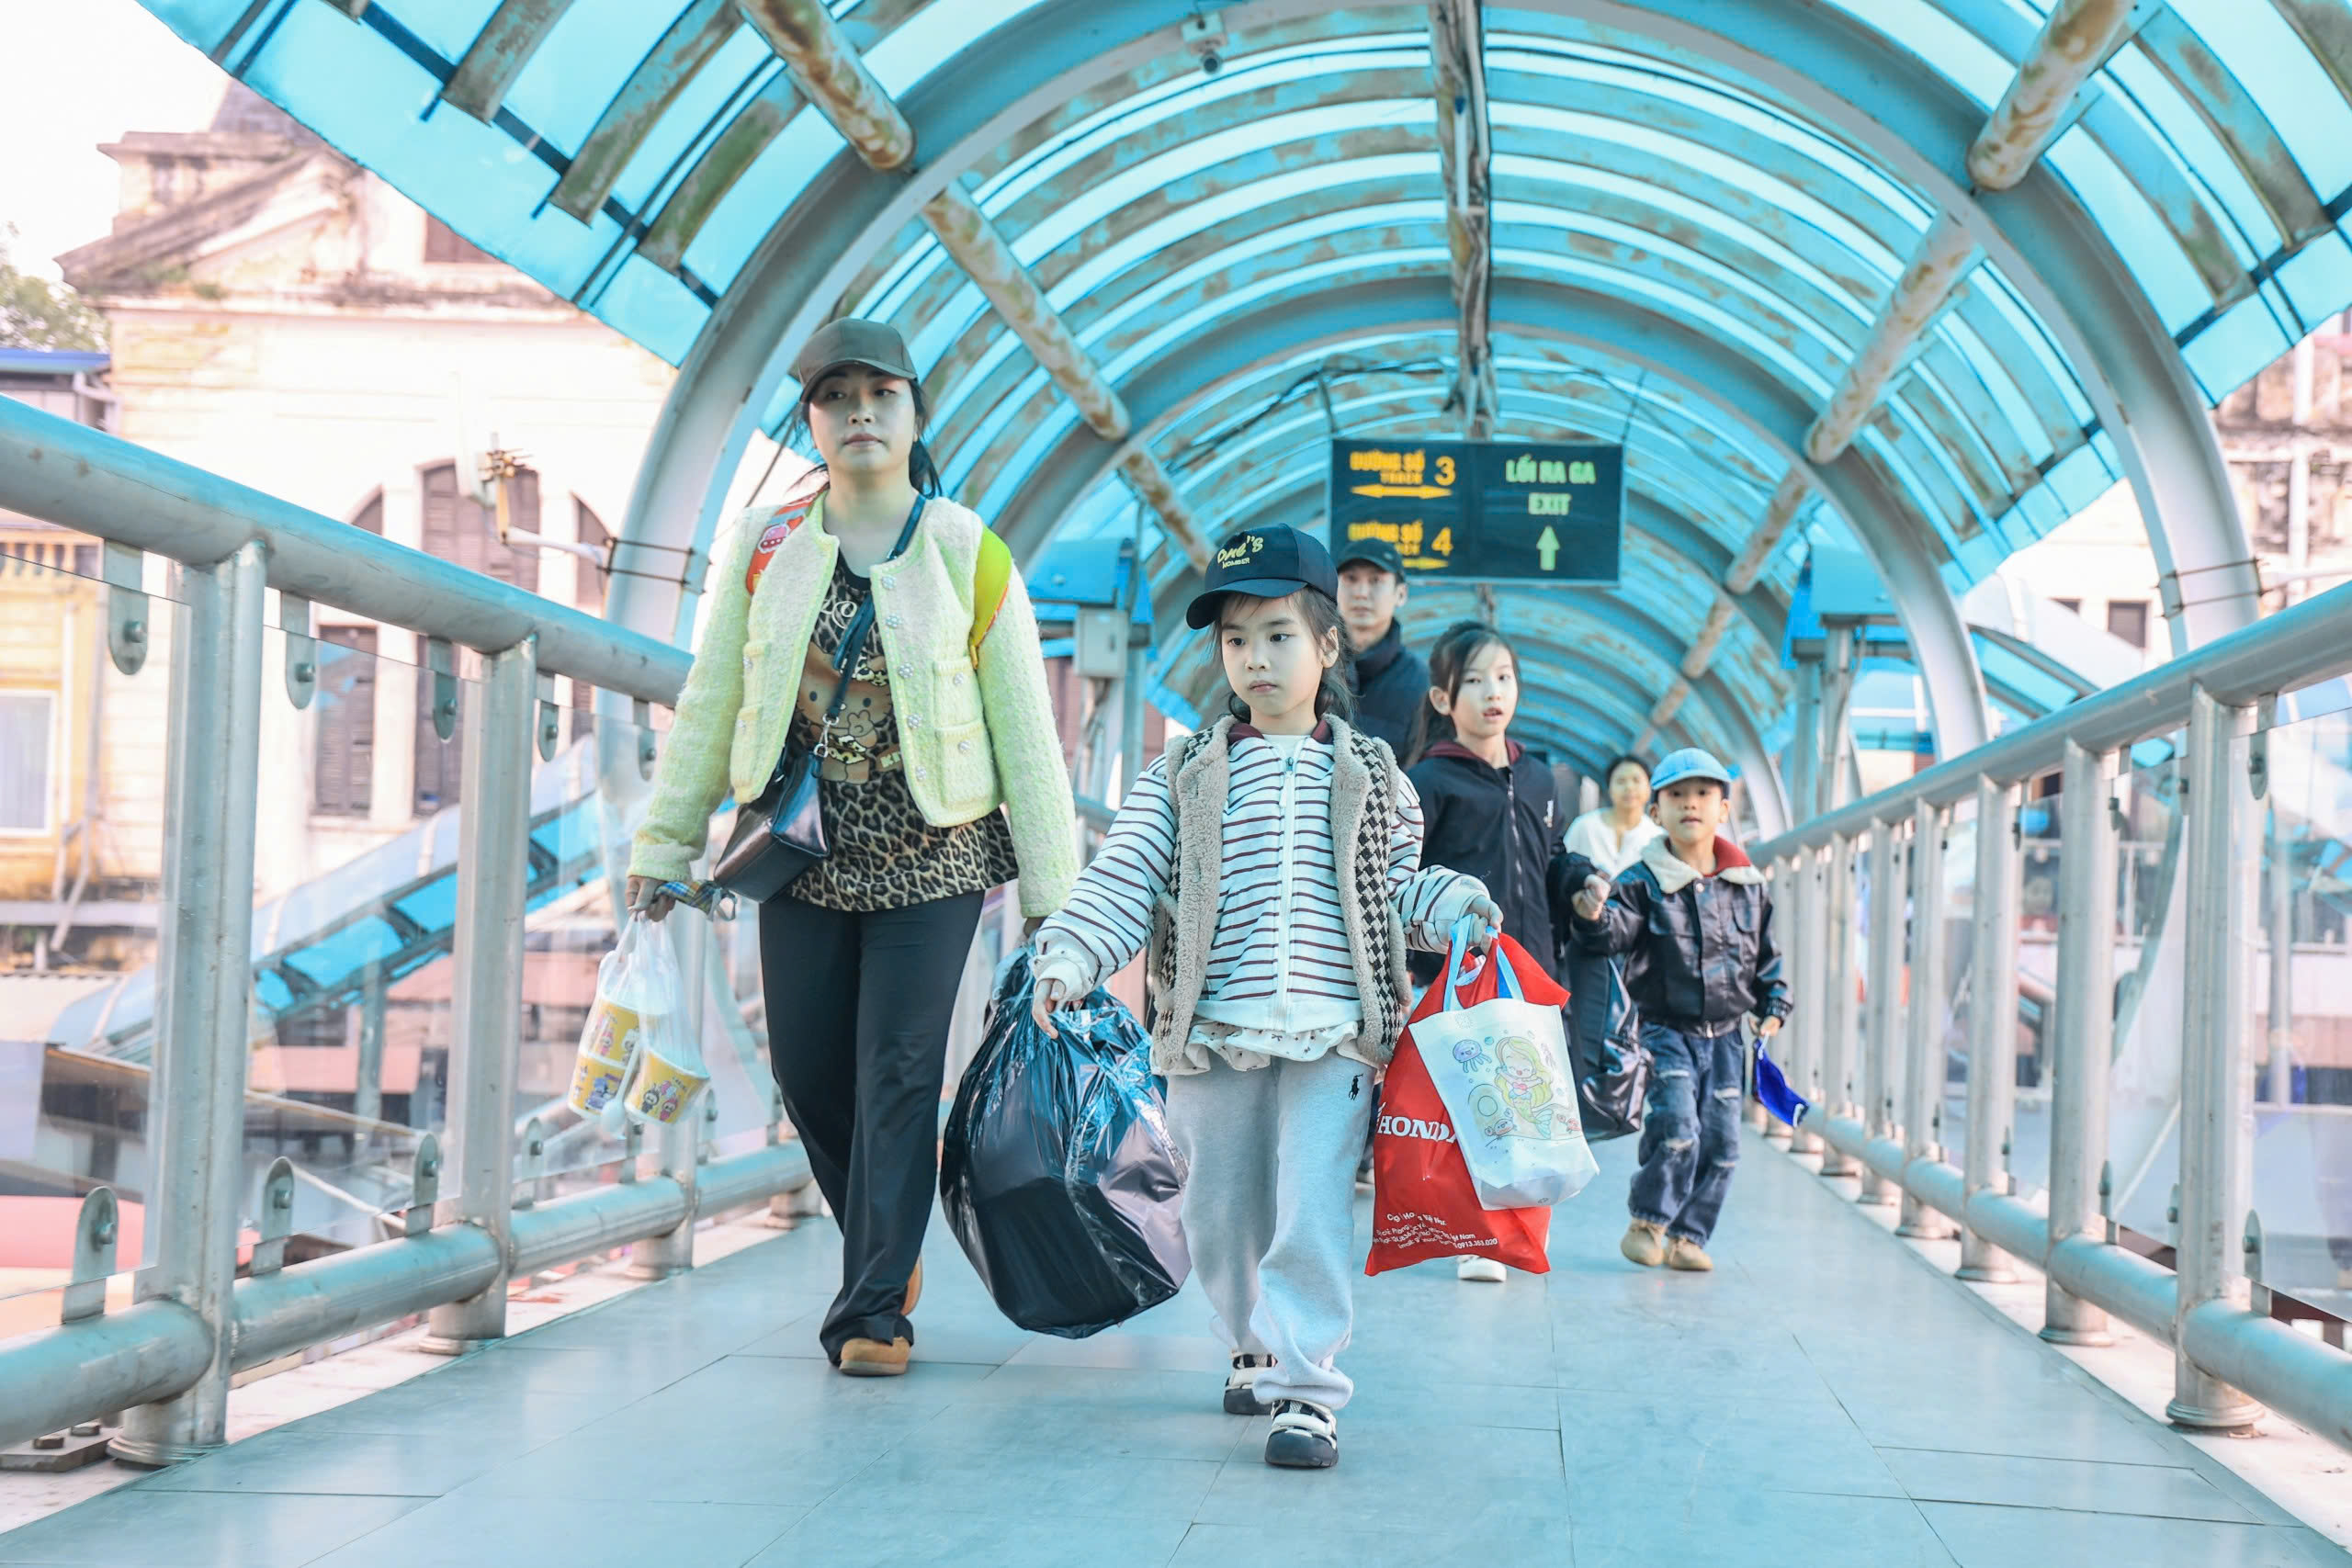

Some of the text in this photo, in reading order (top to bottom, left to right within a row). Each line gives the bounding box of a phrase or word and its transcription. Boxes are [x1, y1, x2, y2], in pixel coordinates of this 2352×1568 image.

[1434, 456, 1456, 486] 3
[1506, 453, 1537, 483] LỐI
[1528, 492, 1572, 515] EXIT
[1431, 526, 1453, 556] 4
